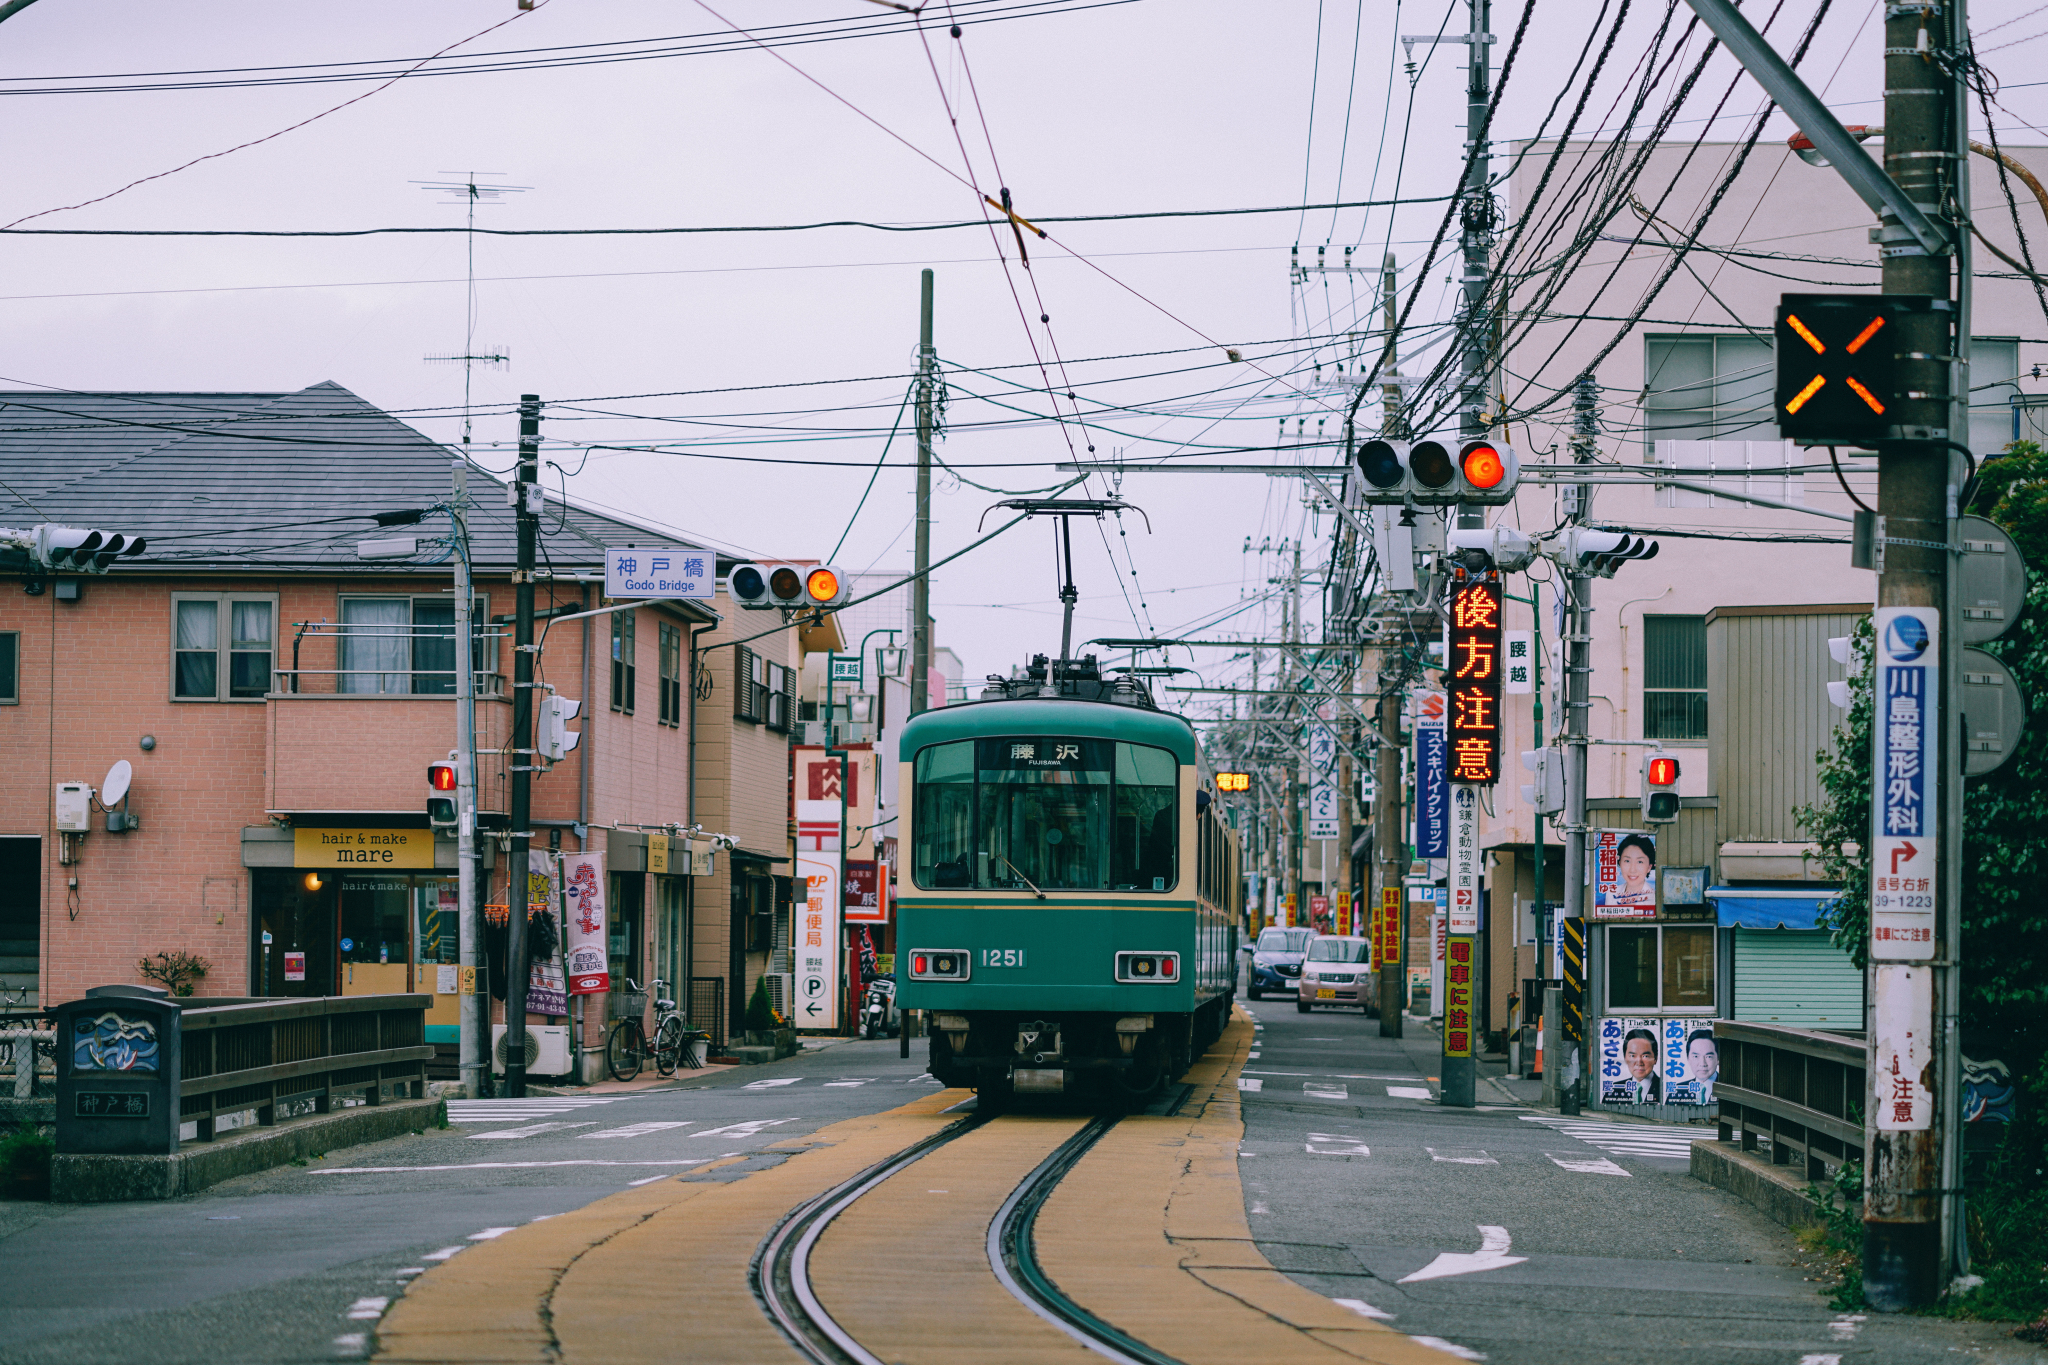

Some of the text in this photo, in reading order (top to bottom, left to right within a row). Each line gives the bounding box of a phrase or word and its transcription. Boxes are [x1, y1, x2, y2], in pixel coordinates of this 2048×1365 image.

[616, 557, 704, 578] 神戸橋
[625, 579, 695, 592] Godo Bridge
[834, 663, 859, 675] 腰越
[1509, 640, 1527, 683] 腰越
[1454, 585, 1497, 780] 後方注意
[1010, 744, 1080, 760] 藤沢
[1887, 669, 1920, 835] 川島整形外科
[1216, 773, 1250, 791] 電車
[1427, 731, 1443, 853] スズキバイクショップ
[321, 833, 408, 845] hair & make
[1458, 809, 1472, 887] 鎌倉動物霊園
[336, 849, 394, 863] mare
[1600, 833, 1617, 882] 早稲田
[1424, 888, 1432, 899] P
[1599, 883, 1617, 893] ゆき
[1877, 877, 1930, 892] 信号右折
[1875, 895, 1932, 908] 39-1223
[805, 896, 823, 948] 郵便局
[1437, 918, 1447, 961] KIRIN
[1874, 926, 1931, 942] 電車にご注意
[982, 949, 1023, 967] 1251
[808, 979, 821, 995] P
[1448, 942, 1471, 1052] 電車に注意
[1602, 1020, 1622, 1077] あさお
[1665, 1020, 1685, 1078] あさお
[1602, 1081, 1638, 1093] 慶一郎
[1666, 1082, 1701, 1094] 慶一郎
[80, 1094, 145, 1114] 神戸橋
